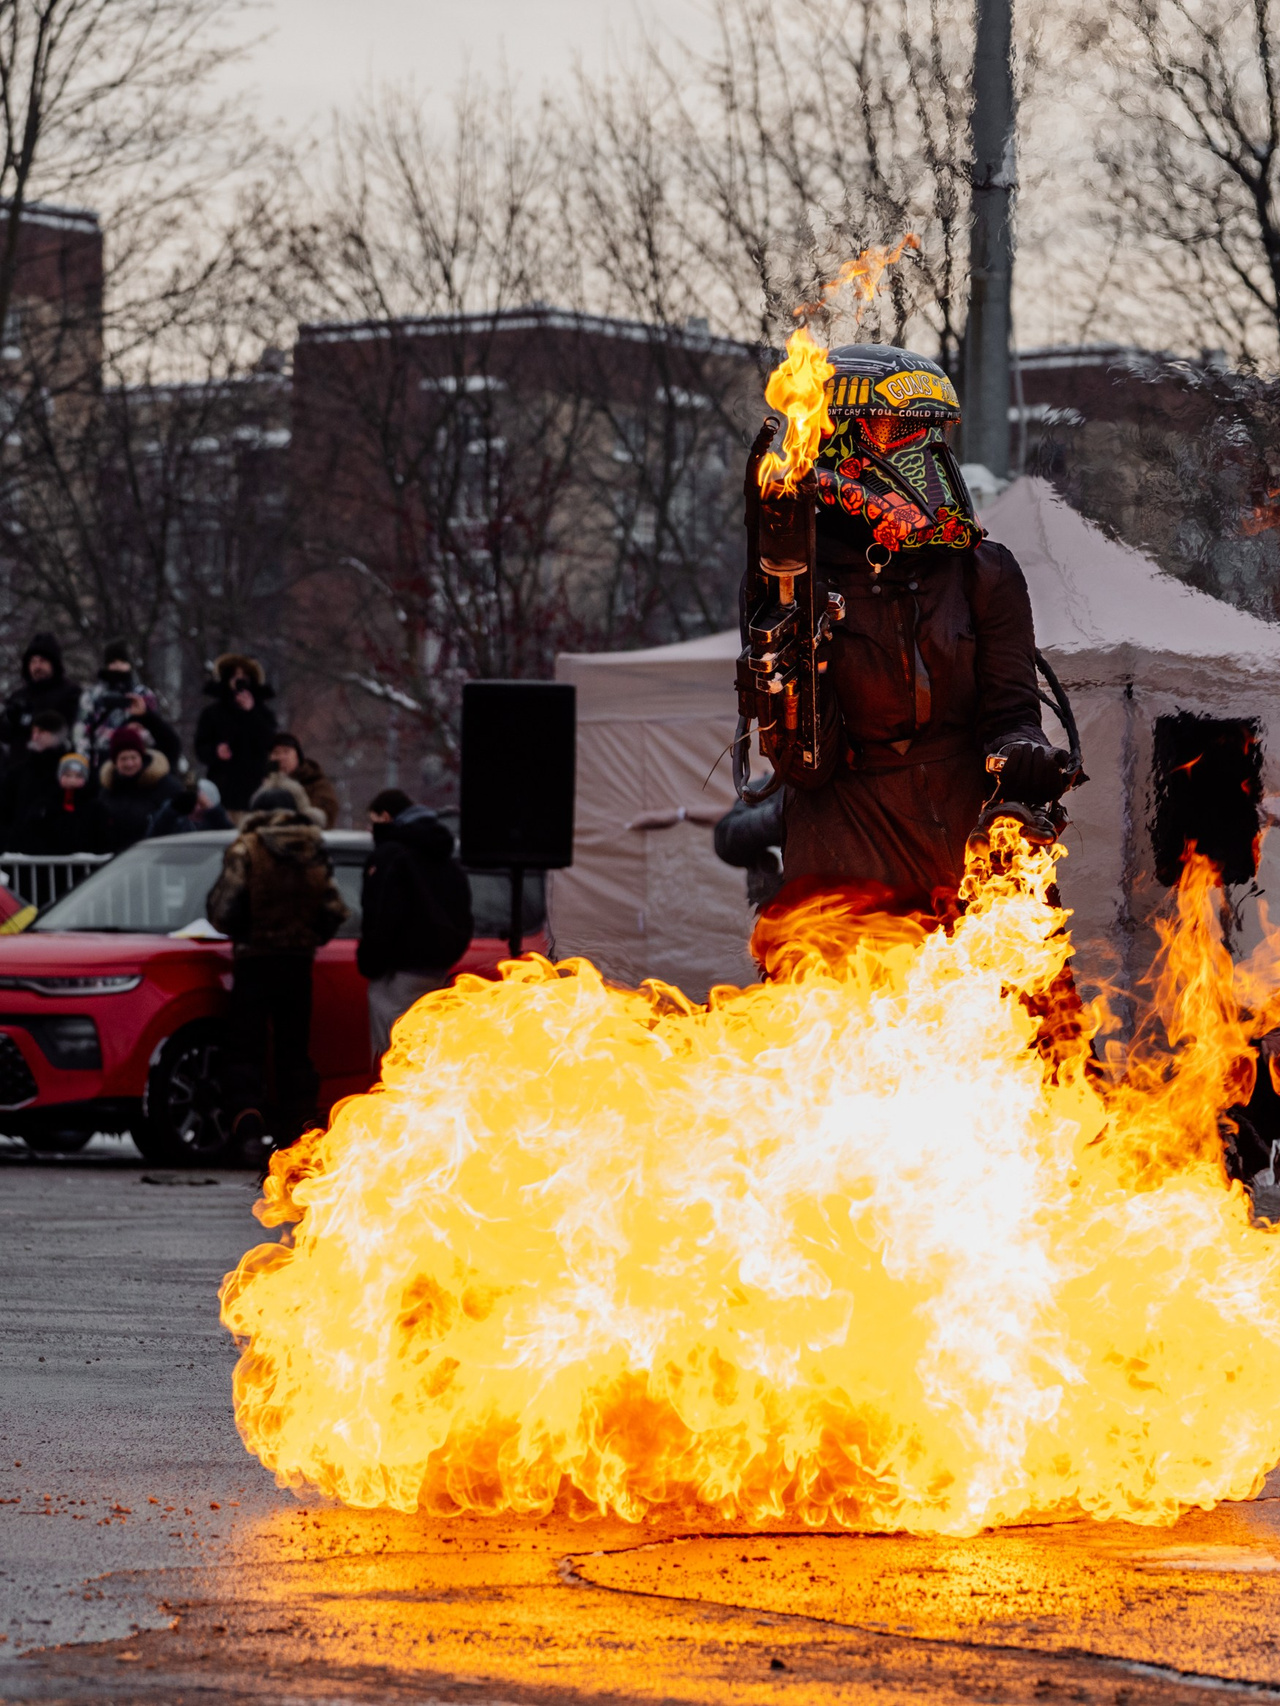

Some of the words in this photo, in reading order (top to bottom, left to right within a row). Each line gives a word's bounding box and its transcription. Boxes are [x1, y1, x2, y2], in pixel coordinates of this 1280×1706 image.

[887, 374, 932, 400] GUNS
[828, 408, 843, 416] ON'T
[870, 408, 892, 416] YOU
[898, 409, 931, 418] COULD
[934, 410, 945, 418] BE
